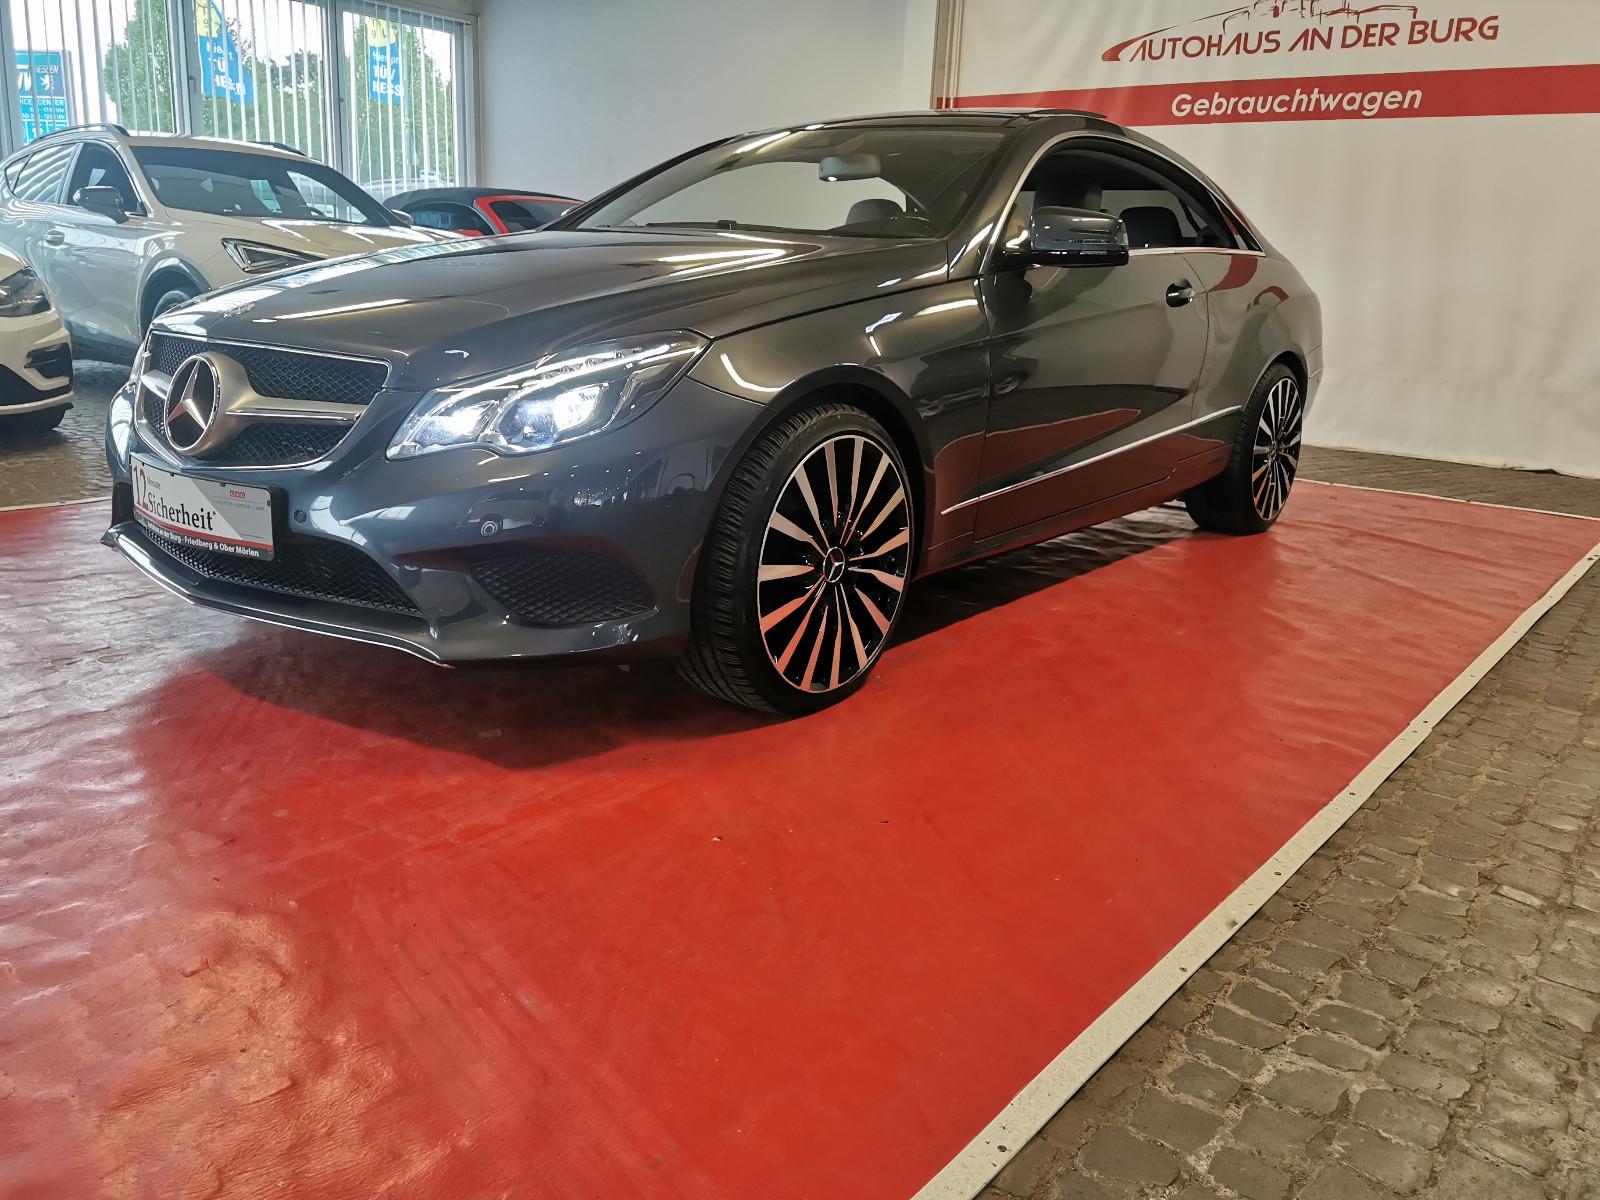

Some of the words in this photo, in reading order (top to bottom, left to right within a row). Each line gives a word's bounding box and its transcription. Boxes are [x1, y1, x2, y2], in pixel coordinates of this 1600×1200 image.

[1129, 30, 1281, 62] AUTOHAUS
[1288, 27, 1334, 53] AN
[1340, 22, 1401, 49] DER
[1407, 15, 1500, 46] BURG
[1171, 87, 1423, 118] Gebrauchtwagen
[184, 535, 213, 551] Friedberg
[213, 541, 219, 550] &
[219, 543, 235, 553] Ober
[235, 546, 260, 558] Mörlen
